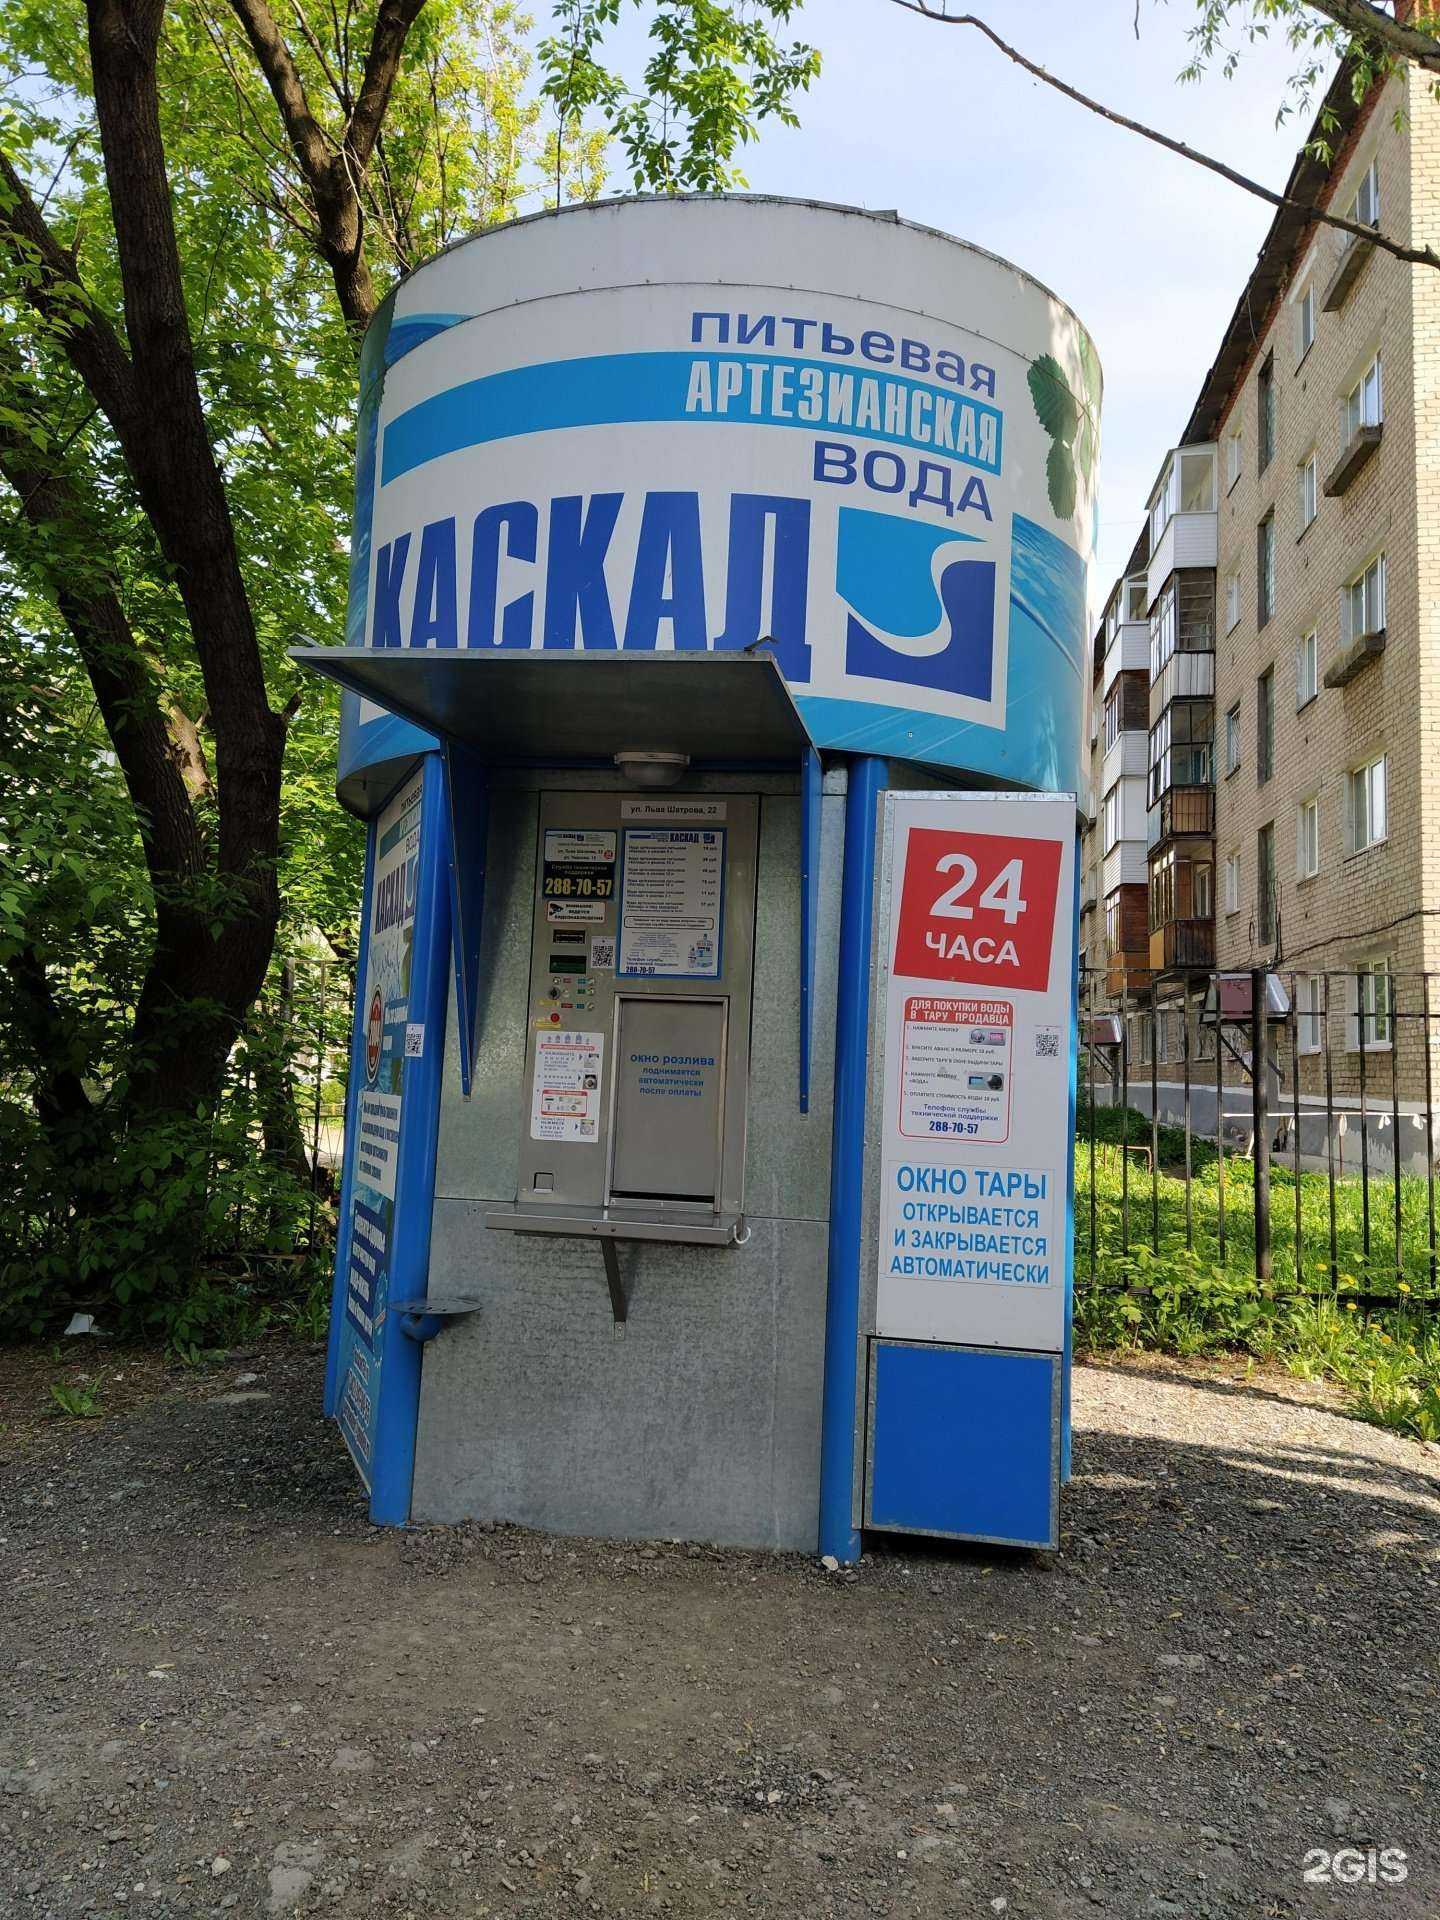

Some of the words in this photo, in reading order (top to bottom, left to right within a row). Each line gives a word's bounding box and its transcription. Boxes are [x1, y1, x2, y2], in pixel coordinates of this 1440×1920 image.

[690, 311, 997, 399] питьевая
[684, 359, 998, 467] АРТЕЗИАНСКАЯ
[812, 440, 994, 523] ВОДА
[372, 491, 812, 684] КАСКАД
[631, 806, 642, 815] ул.
[667, 806, 706, 815] Шатрова,
[545, 878, 613, 897] 288-70-57
[929, 852, 1028, 925] 24
[925, 931, 1021, 967] ЧАСА
[911, 999, 931, 1010] ДЛЯ
[933, 1001, 978, 1012] ПОКУПКИ
[980, 1003, 1010, 1014] ВОДЫ
[911, 1010, 917, 1019] В
[924, 1011, 949, 1020] ТАРУ
[955, 1012, 1009, 1025] ПРОДАВЦА
[631, 1055, 659, 1063] окно
[663, 1056, 715, 1066] розлива
[642, 1068, 701, 1076] поднимается
[639, 1078, 704, 1087] автоматически
[668, 1089, 702, 1097] оплаты
[911, 1111, 957, 1119] технической
[958, 1113, 999, 1121] поддержки
[924, 1104, 956, 1112] Телефон
[929, 1121, 979, 1134] 288-70-57
[897, 1166, 967, 1195] ОКНО
[975, 1170, 1047, 1200] ТАРЫ
[903, 1202, 1039, 1229] ОТКРЫВАЕТСЯ
[895, 1228, 906, 1248] И
[911, 1229, 1047, 1256] ЗАКРЫВАЕТСЯ
[890, 1255, 1049, 1284] АВТОМАТИЧЕСКИ
